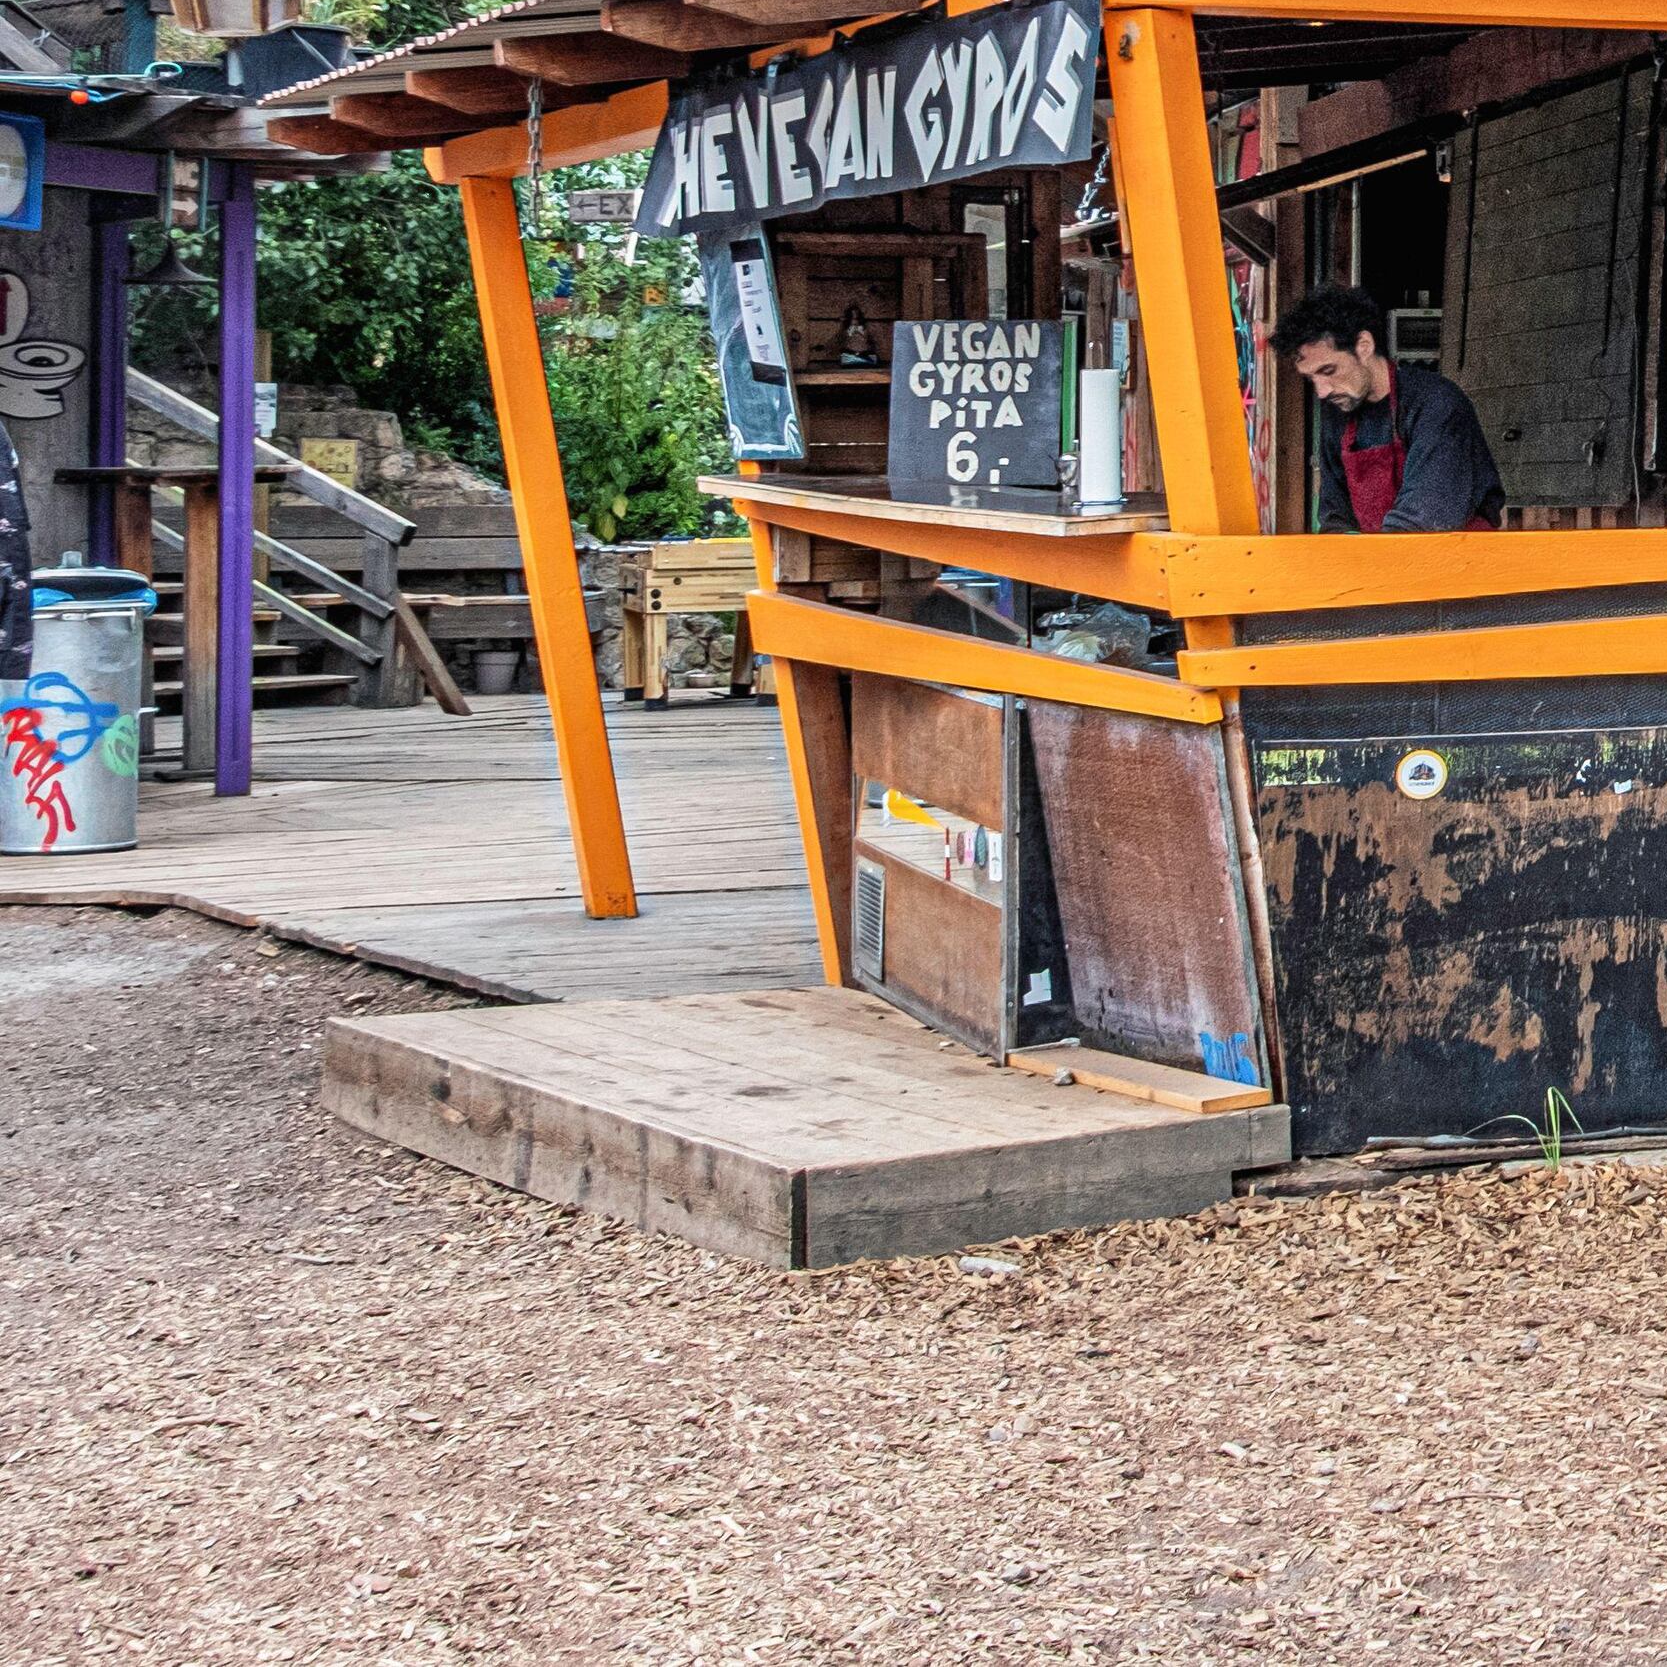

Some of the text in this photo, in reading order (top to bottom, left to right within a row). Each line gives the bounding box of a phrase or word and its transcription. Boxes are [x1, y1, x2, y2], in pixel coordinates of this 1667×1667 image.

[904, 9, 1092, 184] GYROS
[912, 322, 1041, 361] VEGAN
[909, 361, 1033, 397] GYROS
